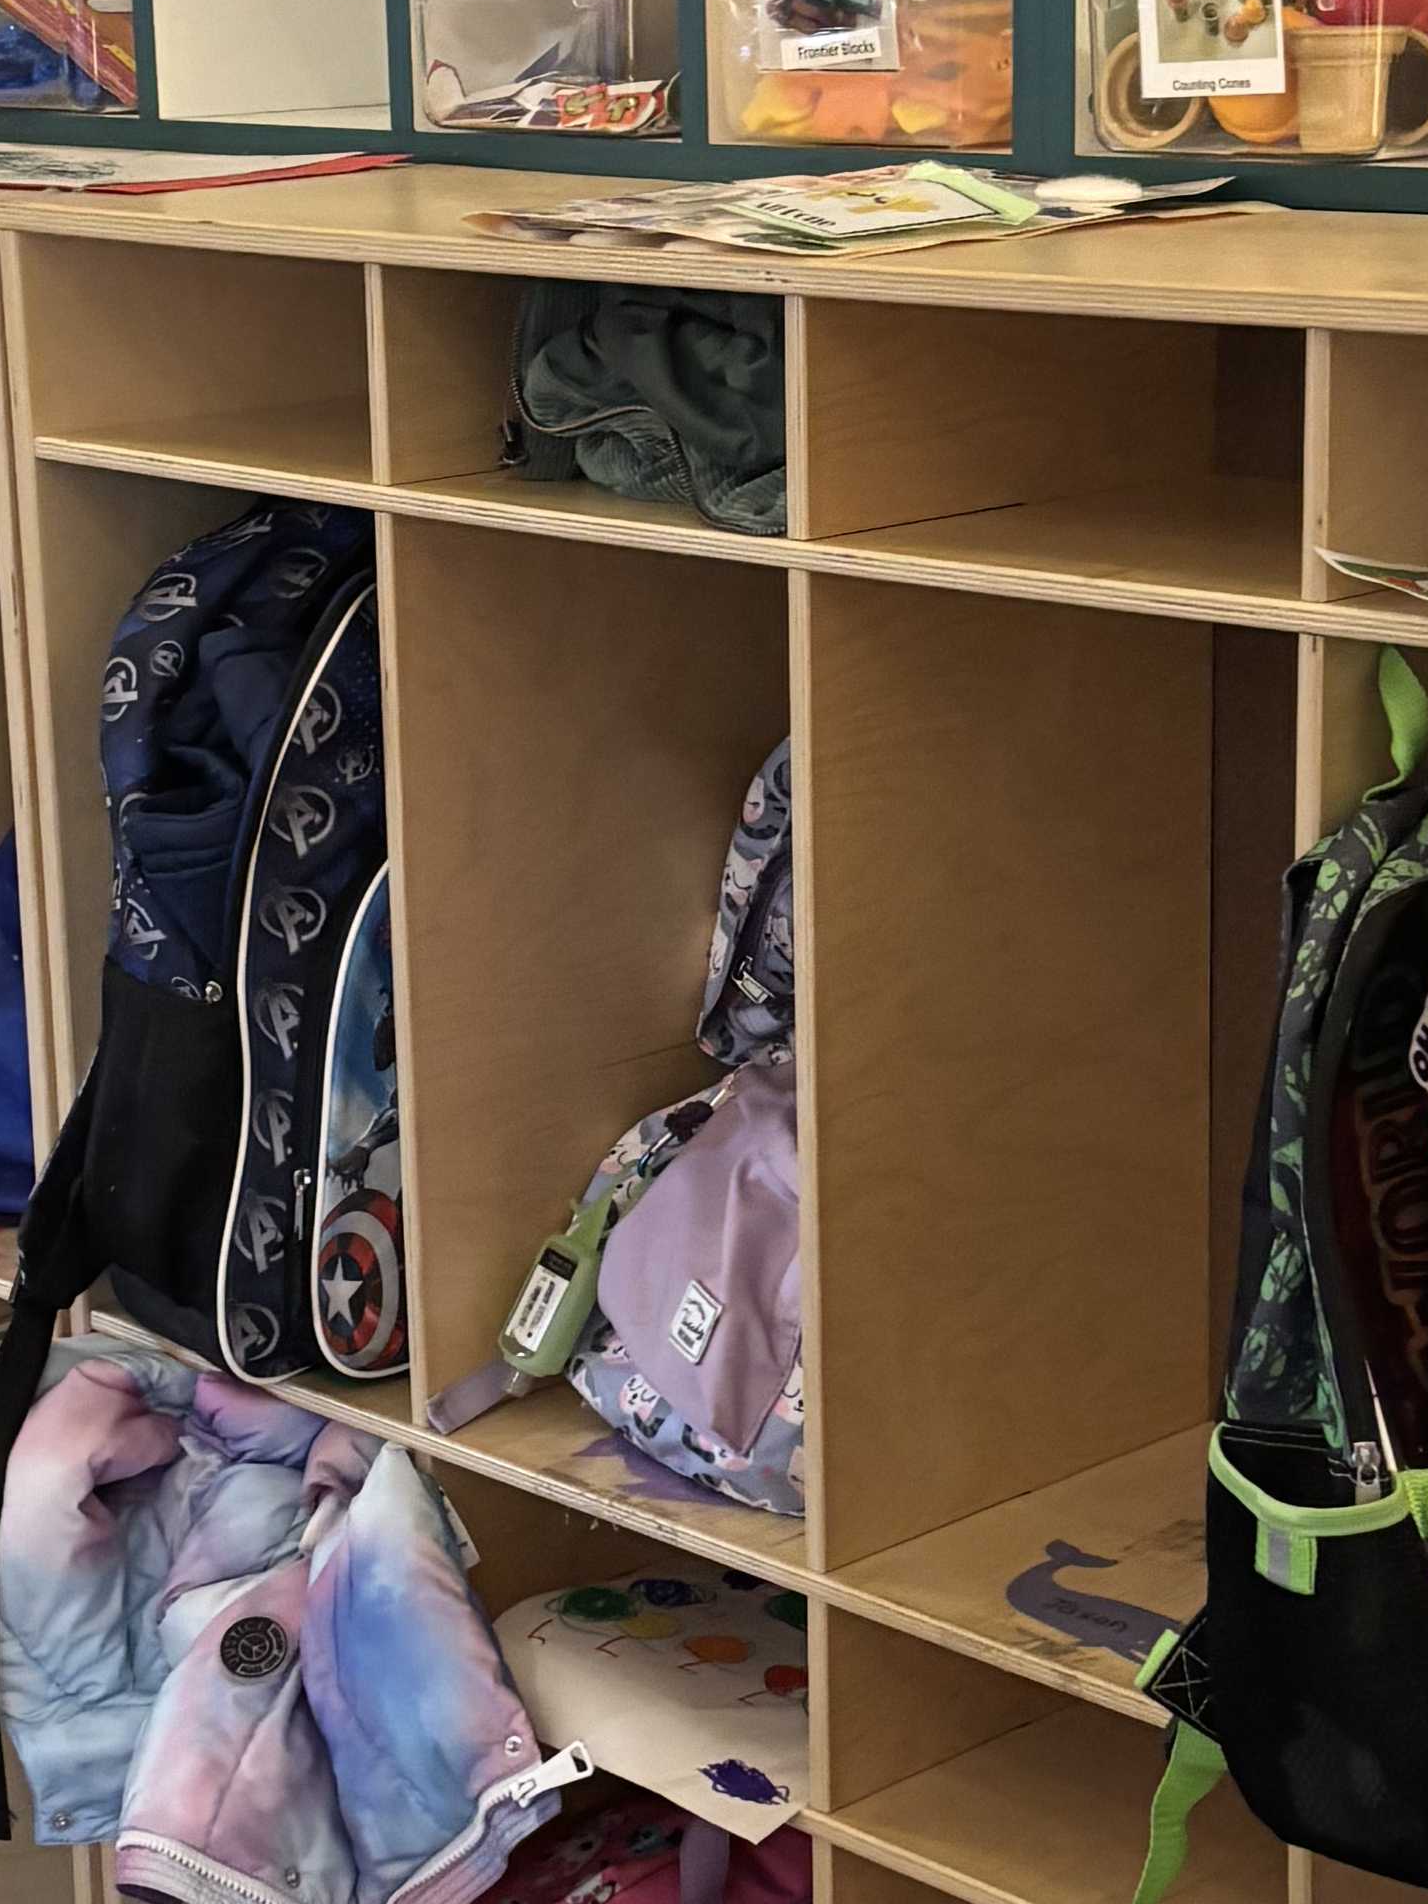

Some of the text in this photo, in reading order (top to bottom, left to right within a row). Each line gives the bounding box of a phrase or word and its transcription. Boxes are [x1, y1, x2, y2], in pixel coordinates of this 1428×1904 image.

[797, 40, 875, 61] Frontier Blocks
[1172, 76, 1251, 93] Counting Cones
